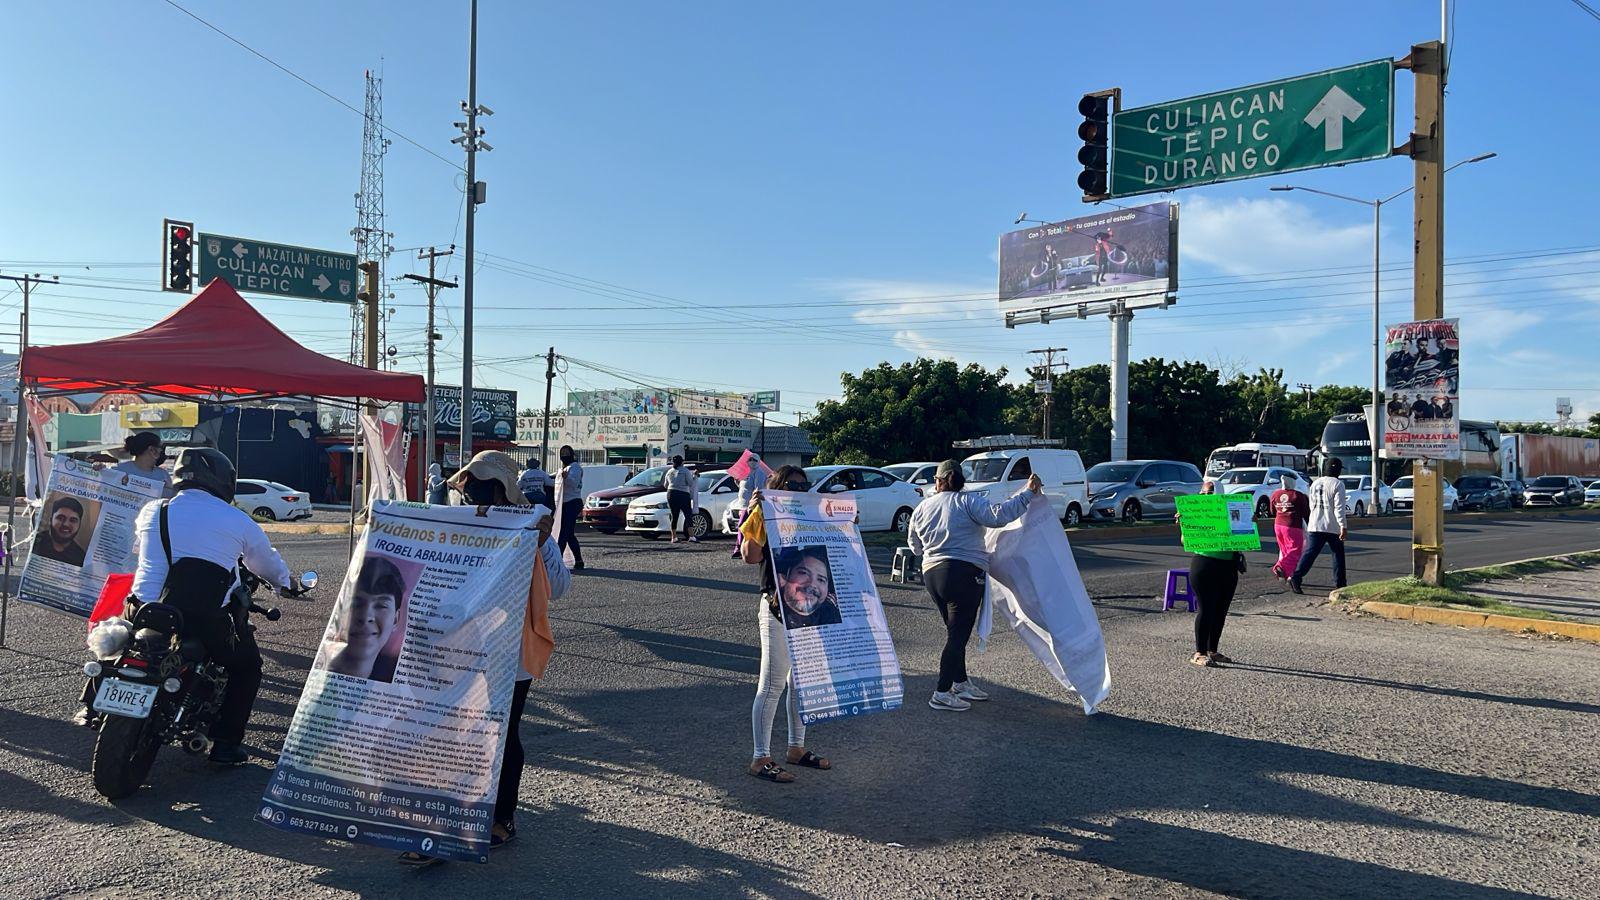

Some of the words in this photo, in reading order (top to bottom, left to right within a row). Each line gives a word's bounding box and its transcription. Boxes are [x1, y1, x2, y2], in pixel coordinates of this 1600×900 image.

[1147, 89, 1285, 134] CULIACAN
[1161, 118, 1270, 156] TEPIC
[1145, 144, 1281, 185] DURANGO
[1028, 232, 1039, 240] Con
[1113, 213, 1136, 223] estadio
[217, 257, 305, 279] CULIACAN
[258, 246, 351, 271] MAZATLAN-CENTRO
[235, 273, 291, 292] TEPIC
[472, 390, 510, 401] PINTURAS
[528, 419, 534, 428] Y
[536, 418, 565, 428] REGO
[56, 484, 76, 494] OSCAR
[78, 489, 98, 499] DAVID
[439, 532, 446, 544] a
[779, 535, 798, 545] JESÚS
[799, 535, 825, 543] ANTONIO
[374, 538, 412, 560] IROBEL
[414, 549, 461, 565] ABRAJAN
[103, 687, 148, 707] 18VRE4
[807, 687, 825, 697] tienes
[277, 770, 285, 782] Si
[287, 773, 310, 787] tienes
[314, 779, 365, 799] información
[369, 791, 411, 807] referente
[415, 799, 421, 808] a
[425, 801, 446, 812] esta
[450, 804, 490, 820] persona,
[271, 783, 293, 798] llama
[294, 792, 300, 800] o
[355, 802, 366, 812] Tu
[368, 806, 396, 819] ayuda
[398, 811, 410, 820] es
[412, 812, 432, 825] muy
[435, 814, 488, 833] importante.
[289, 816, 303, 827] 669
[304, 819, 319, 830] 327
[319, 821, 339, 834] 8424
